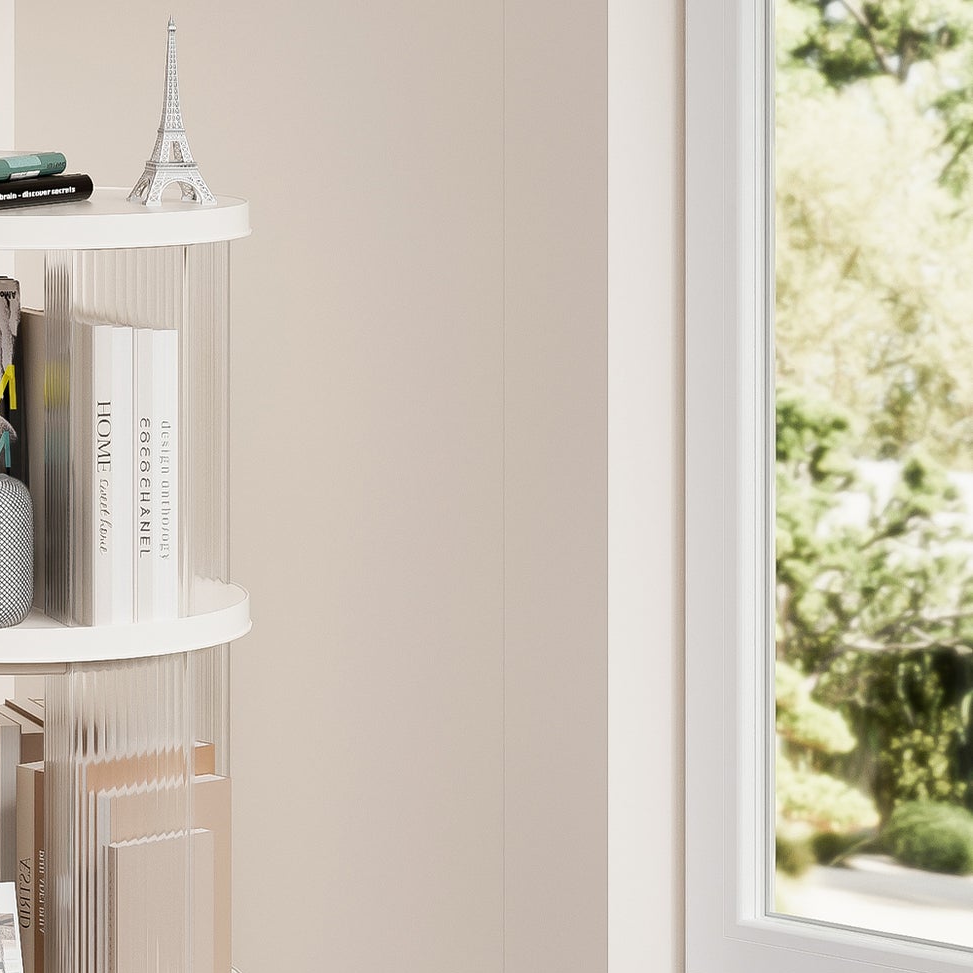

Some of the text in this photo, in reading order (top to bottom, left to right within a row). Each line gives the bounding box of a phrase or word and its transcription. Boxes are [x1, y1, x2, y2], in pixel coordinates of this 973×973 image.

[0, 192, 17, 201] brain
[22, 188, 51, 199] discover
[51, 186, 76, 195] secrets
[97, 401, 111, 473] HOME
